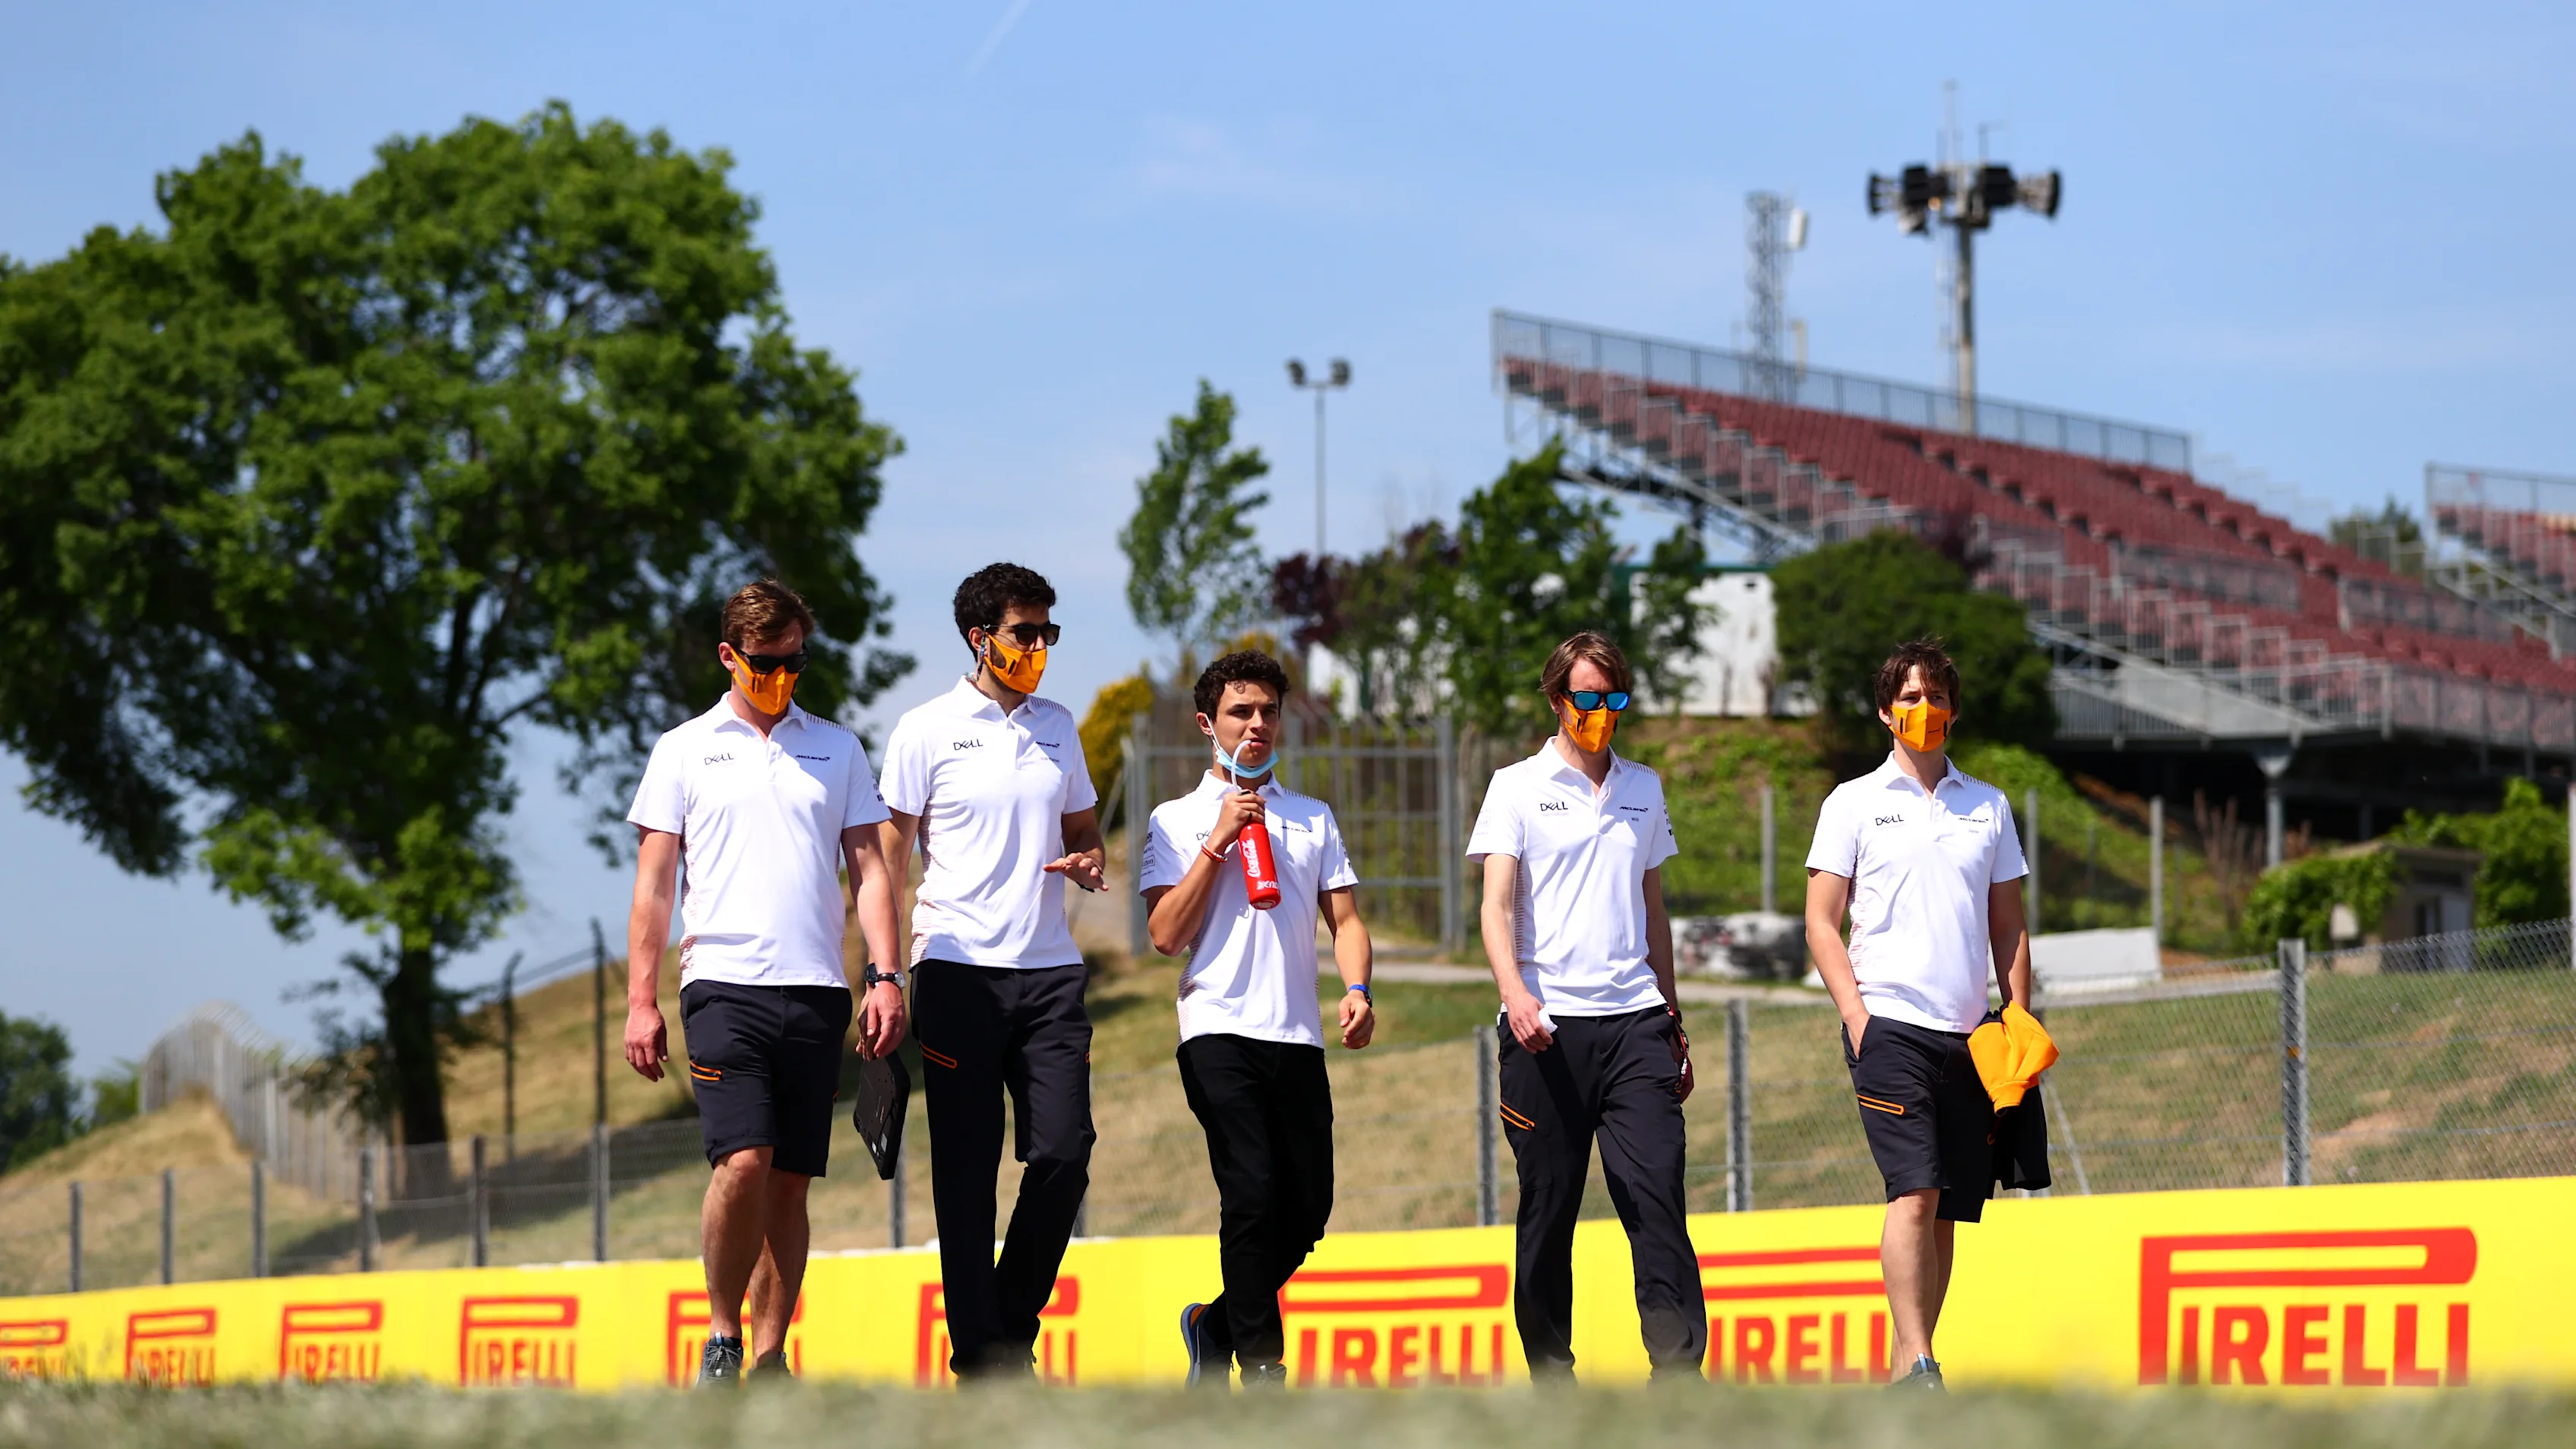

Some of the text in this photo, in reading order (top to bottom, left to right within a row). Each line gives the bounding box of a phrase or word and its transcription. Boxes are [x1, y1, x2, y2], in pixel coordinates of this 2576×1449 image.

[703, 753, 734, 766] DELL
[953, 739, 983, 751] DELL
[1539, 800, 1569, 812] DELL
[1874, 813, 1905, 826] DELL
[1196, 830, 1211, 841] DE
[1277, 1263, 1511, 1388] PIRELLI
[1696, 1245, 1891, 1385] IRELL
[2139, 1226, 2479, 1387] PIRELLI
[278, 1299, 384, 1382] PIRELLI
[458, 1295, 580, 1387] PIRELLI
